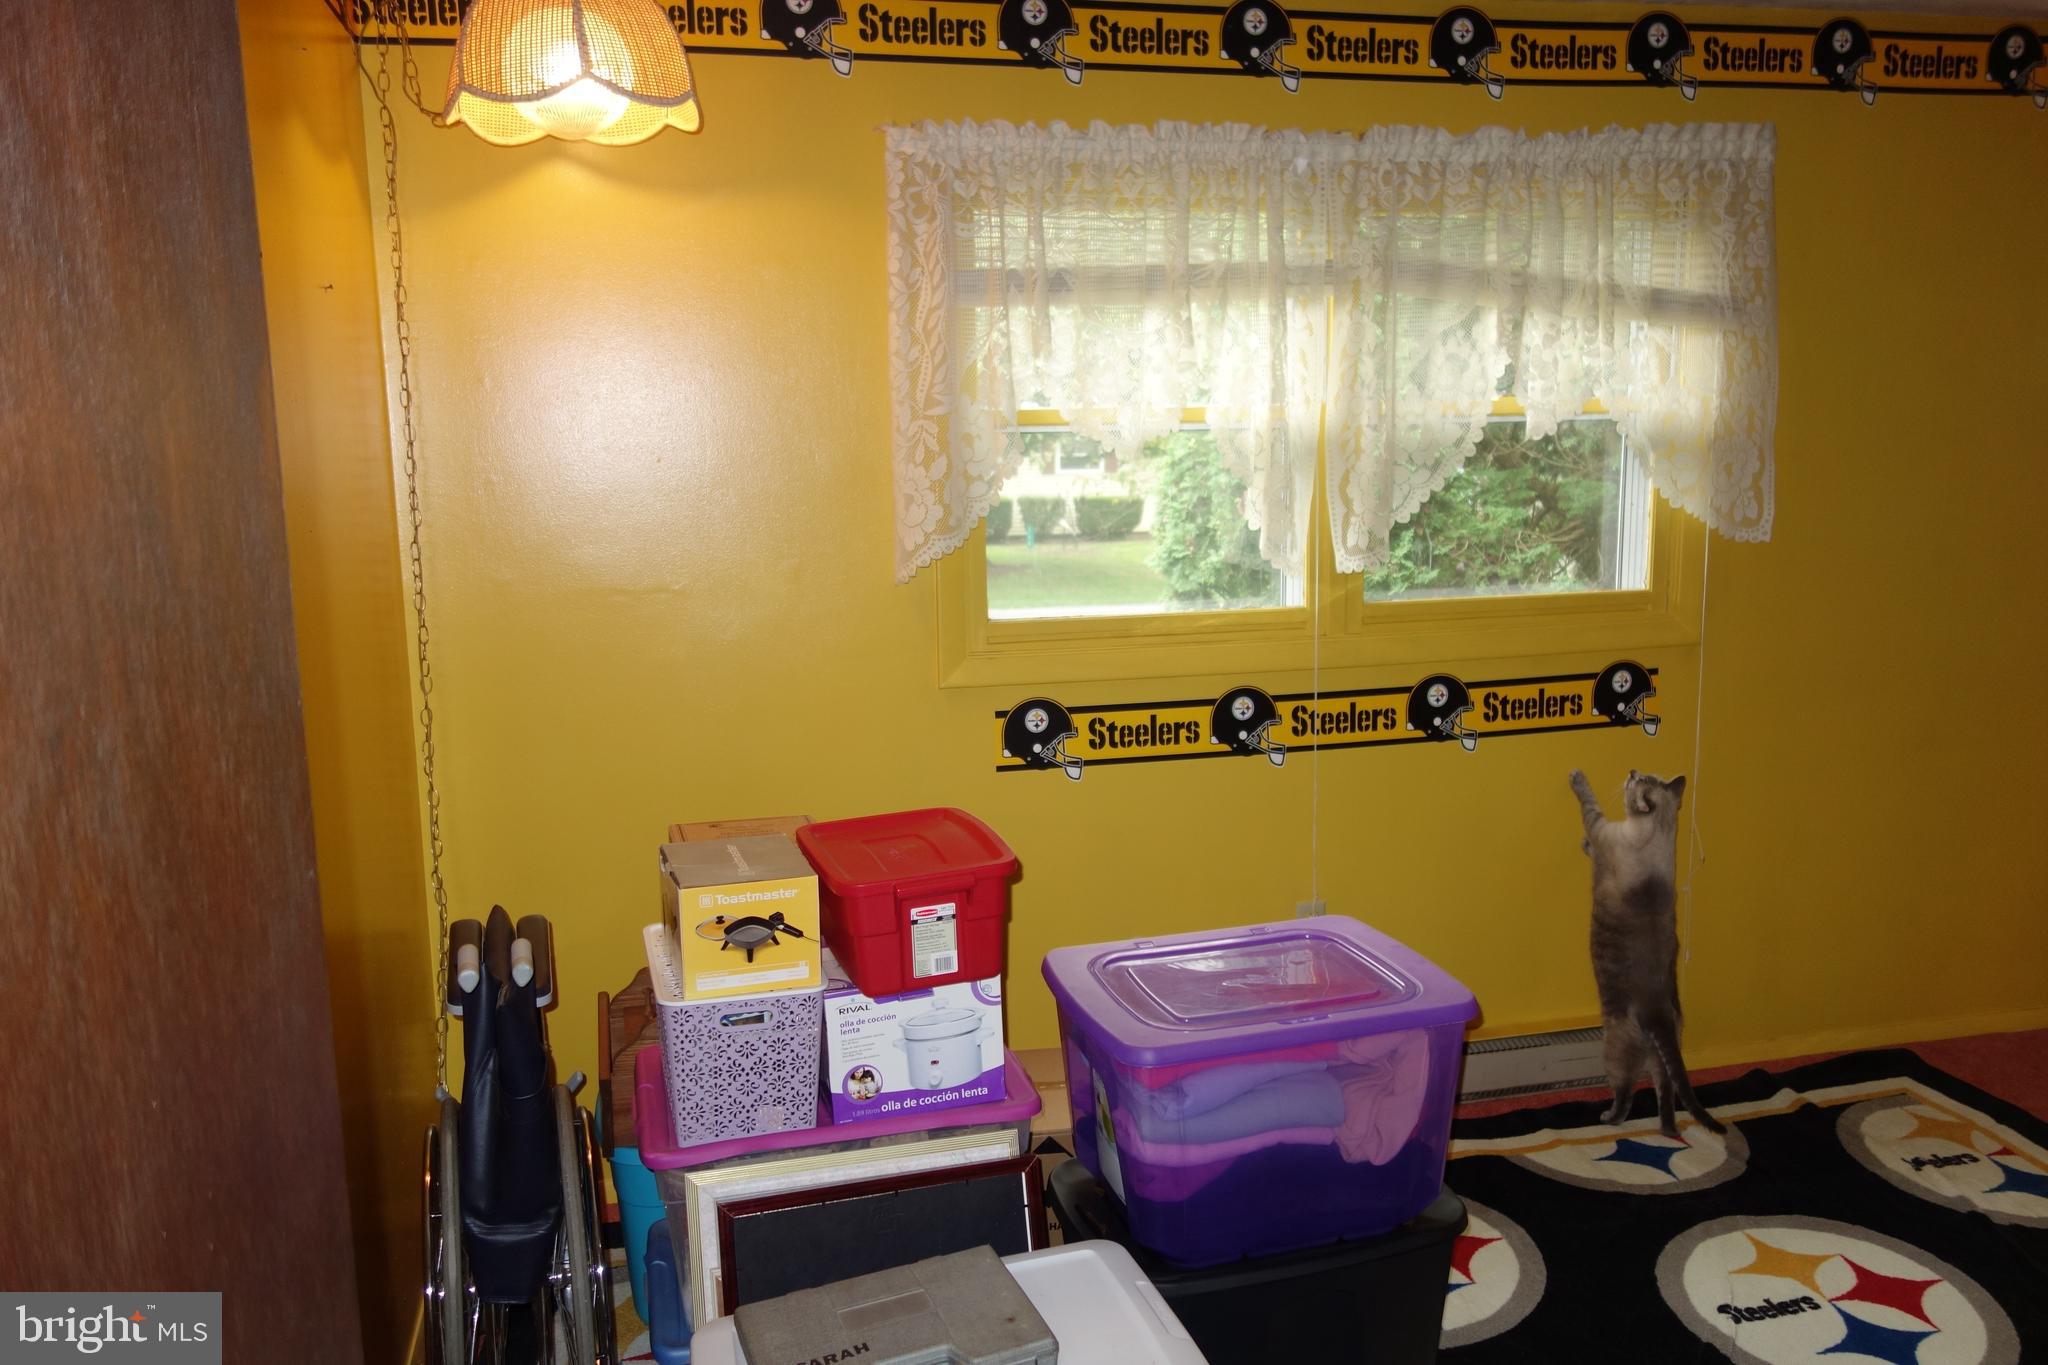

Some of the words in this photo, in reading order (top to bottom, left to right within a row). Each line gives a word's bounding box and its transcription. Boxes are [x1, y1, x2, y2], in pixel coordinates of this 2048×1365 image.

[668, 0, 748, 37] elers
[858, 2, 987, 47] Steelers
[1089, 15, 1209, 57] Steelers
[1306, 24, 1419, 65] Steelers
[1510, 33, 1617, 71] Steelers
[1703, 36, 1803, 73] Steelers
[1883, 44, 1978, 80] Steelers
[1088, 714, 1200, 750] Steelers
[1291, 702, 1397, 737] Steelers
[1483, 688, 1583, 723] Steelers
[715, 888, 799, 905] Toastmaster
[839, 1004, 871, 1015] RIVAL
[856, 1018, 866, 1026] de
[867, 1013, 897, 1024] cocción
[840, 1027, 860, 1035] lenta
[881, 1100, 901, 1112] olla
[903, 1098, 917, 1109] de
[919, 1090, 959, 1105] cocción
[961, 1087, 988, 1098] lenta
[1717, 1296, 1821, 1325] Steelers
[797, 1342, 870, 1365] ARAH
